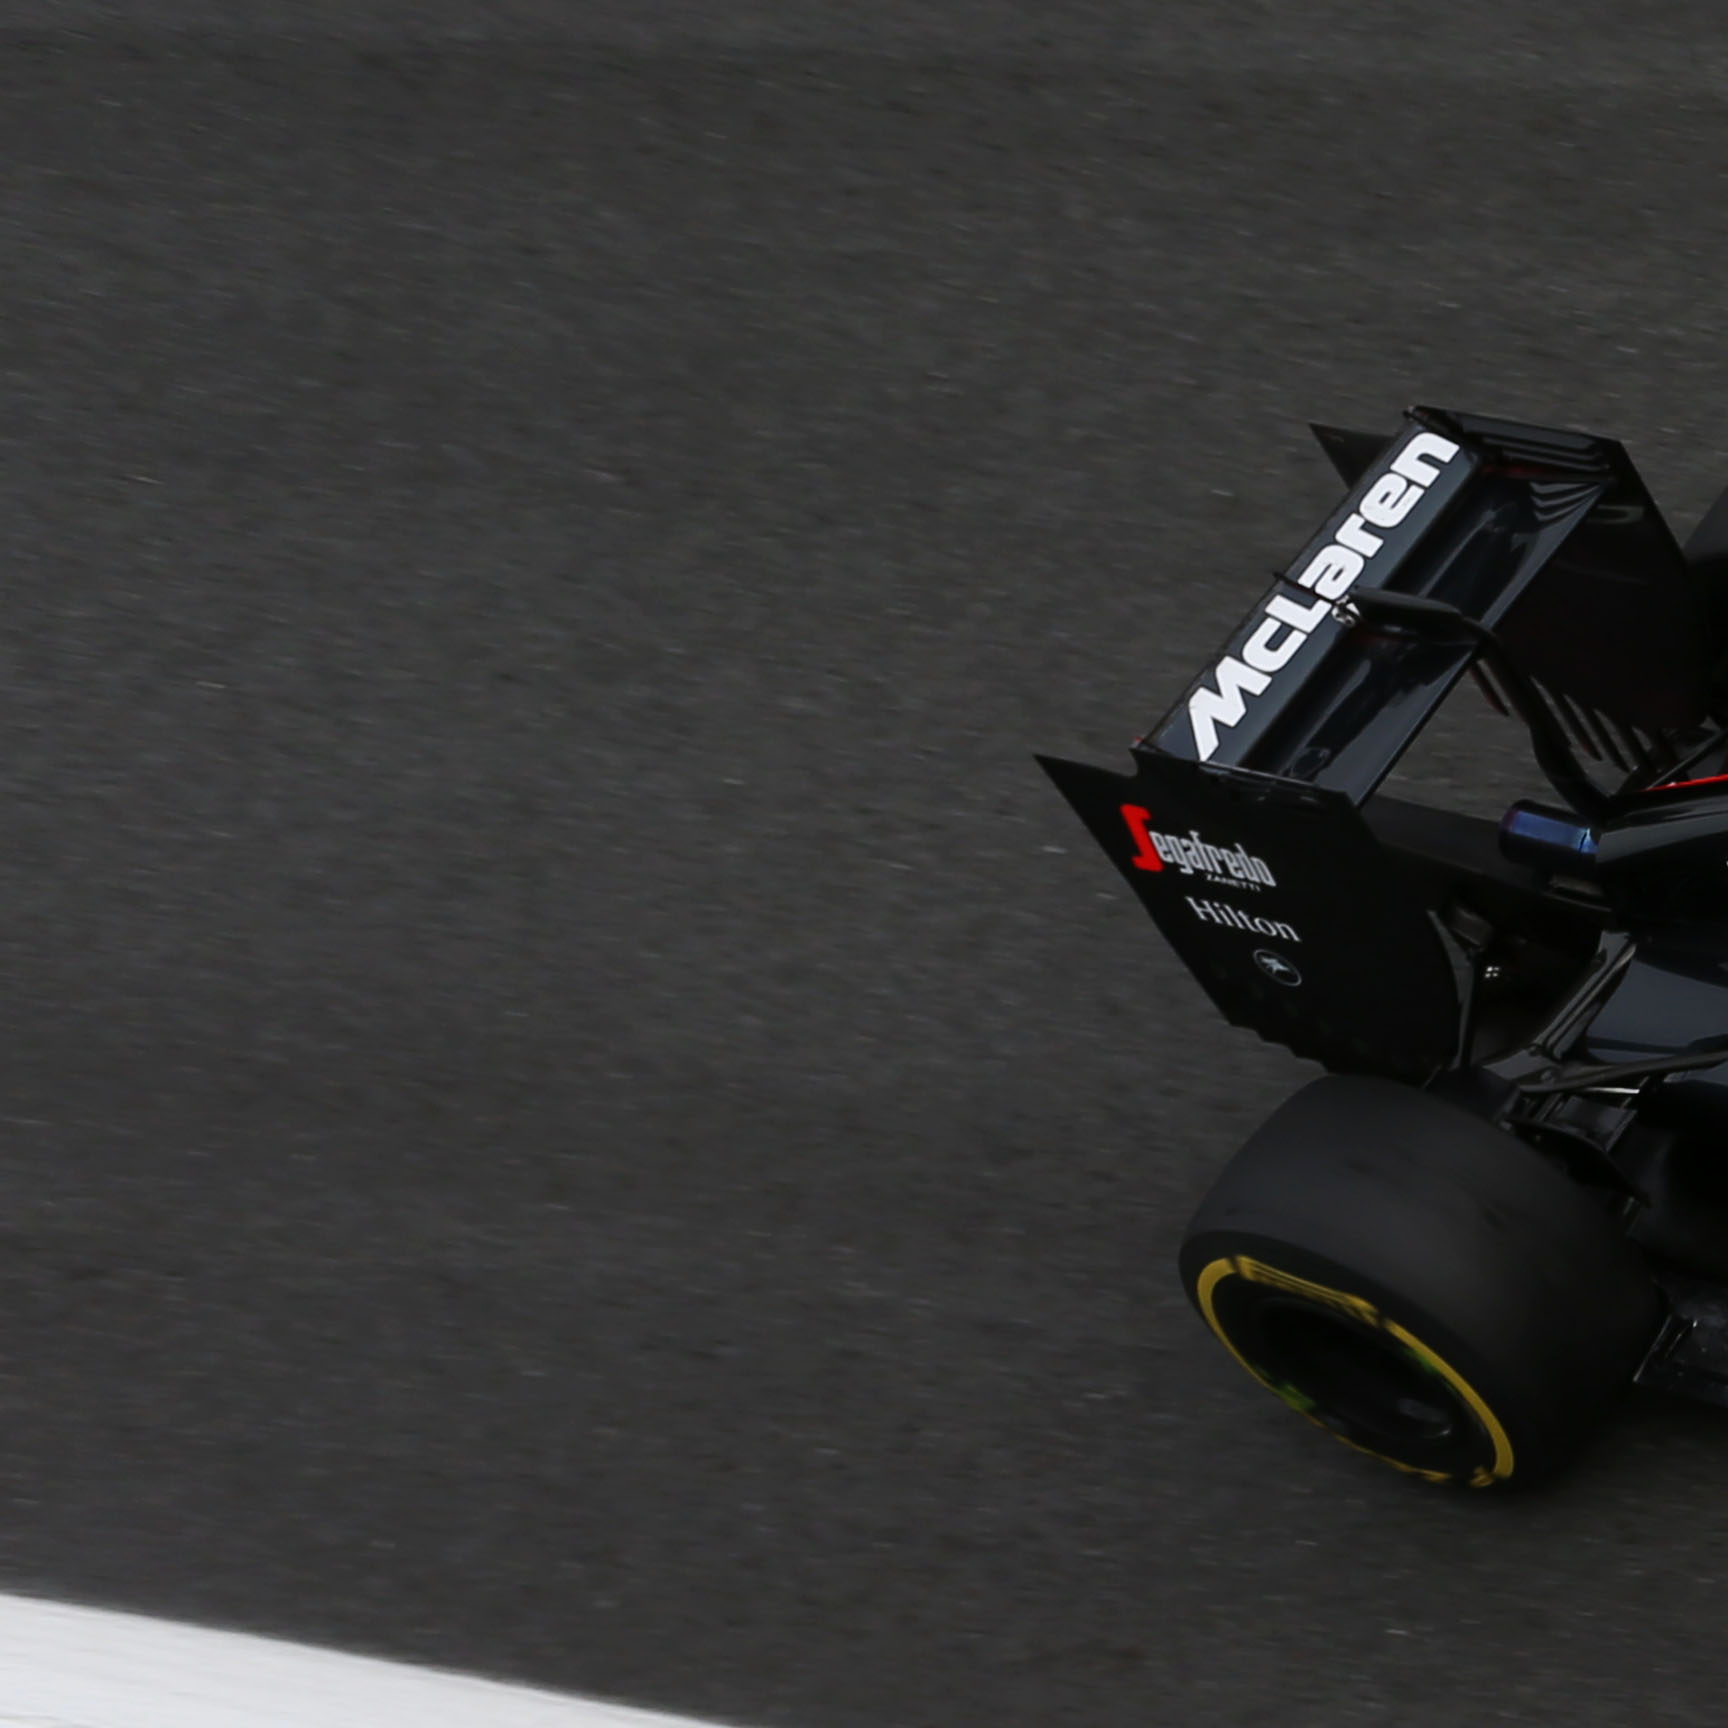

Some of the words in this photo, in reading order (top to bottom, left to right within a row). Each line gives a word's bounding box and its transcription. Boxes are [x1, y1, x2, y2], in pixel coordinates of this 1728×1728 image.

[1188, 432, 1460, 761] McLaren
[1119, 803, 1277, 887] Segafredo
[1184, 895, 1301, 942] Hilton
